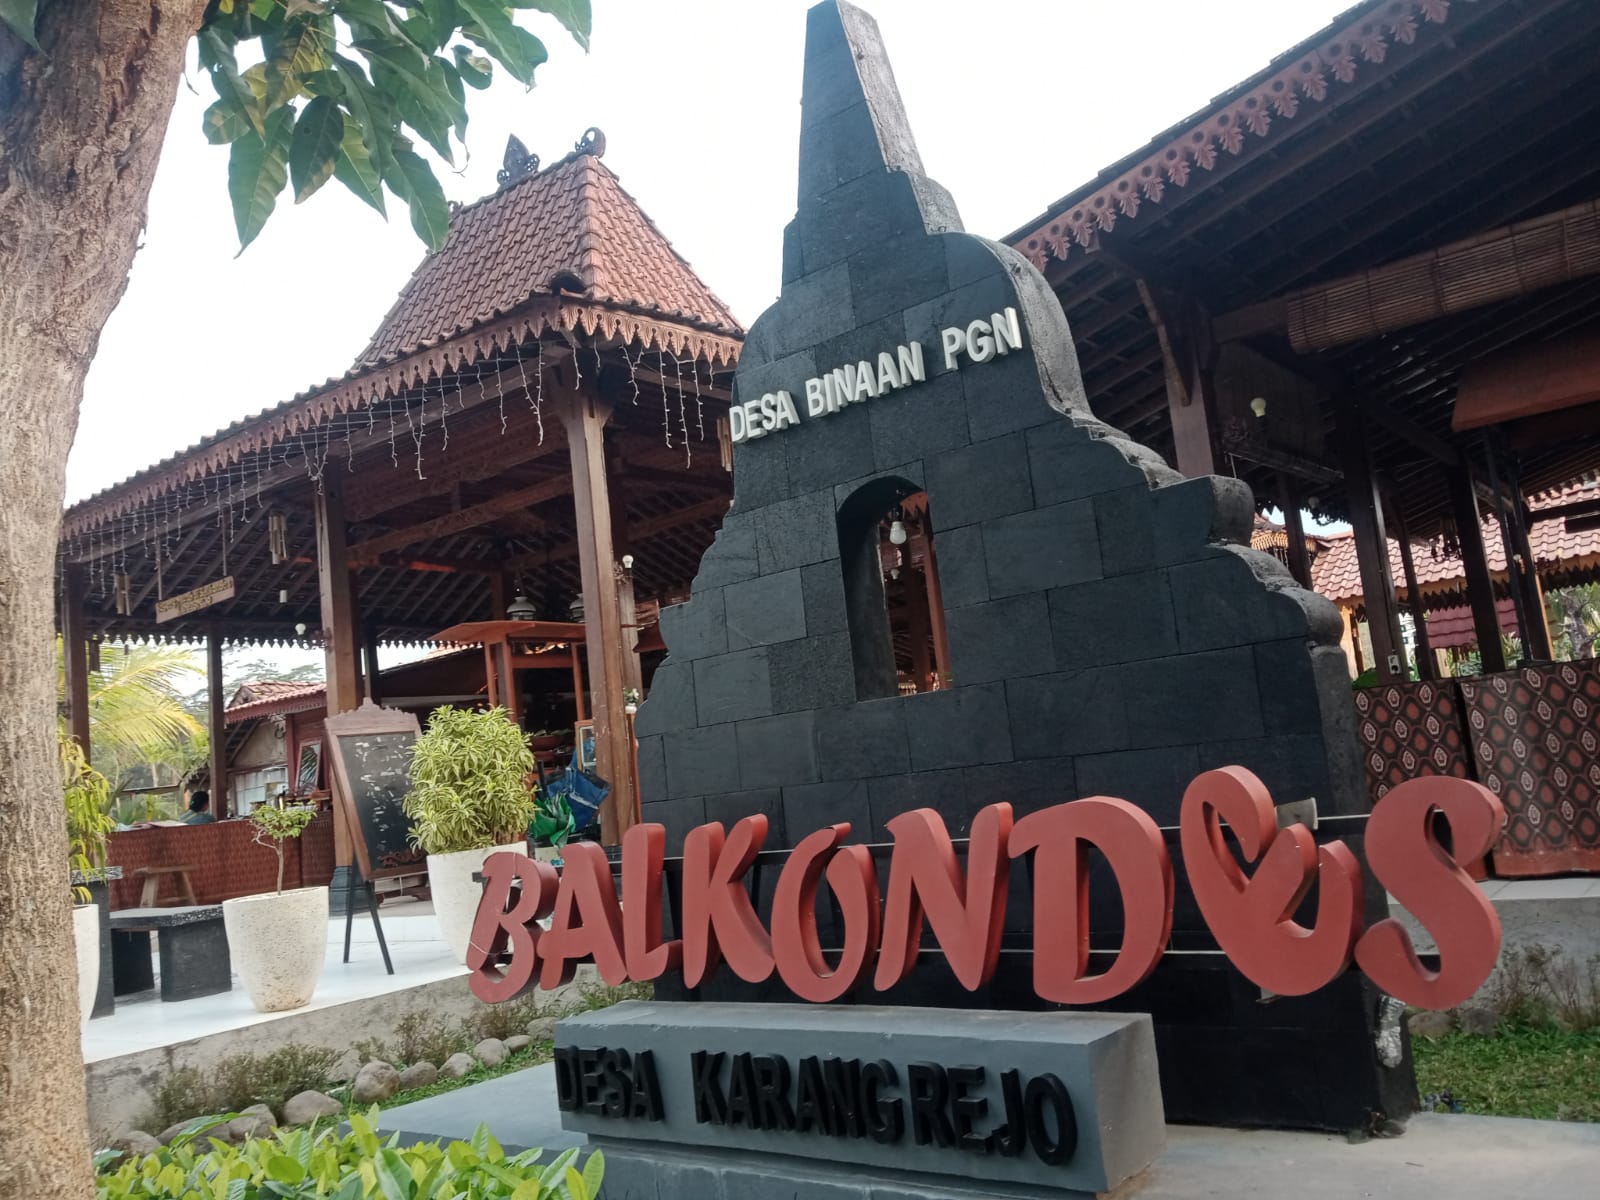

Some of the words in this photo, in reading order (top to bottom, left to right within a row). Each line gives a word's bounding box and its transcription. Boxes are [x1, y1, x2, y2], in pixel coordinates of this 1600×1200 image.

[729, 390, 800, 443] DESA
[805, 341, 926, 418] BINAAN
[941, 307, 1023, 371] PGN
[467, 764, 1504, 1012] BALKONDES
[554, 1044, 666, 1122] DESA
[691, 1050, 1079, 1166] KARANGREJO
